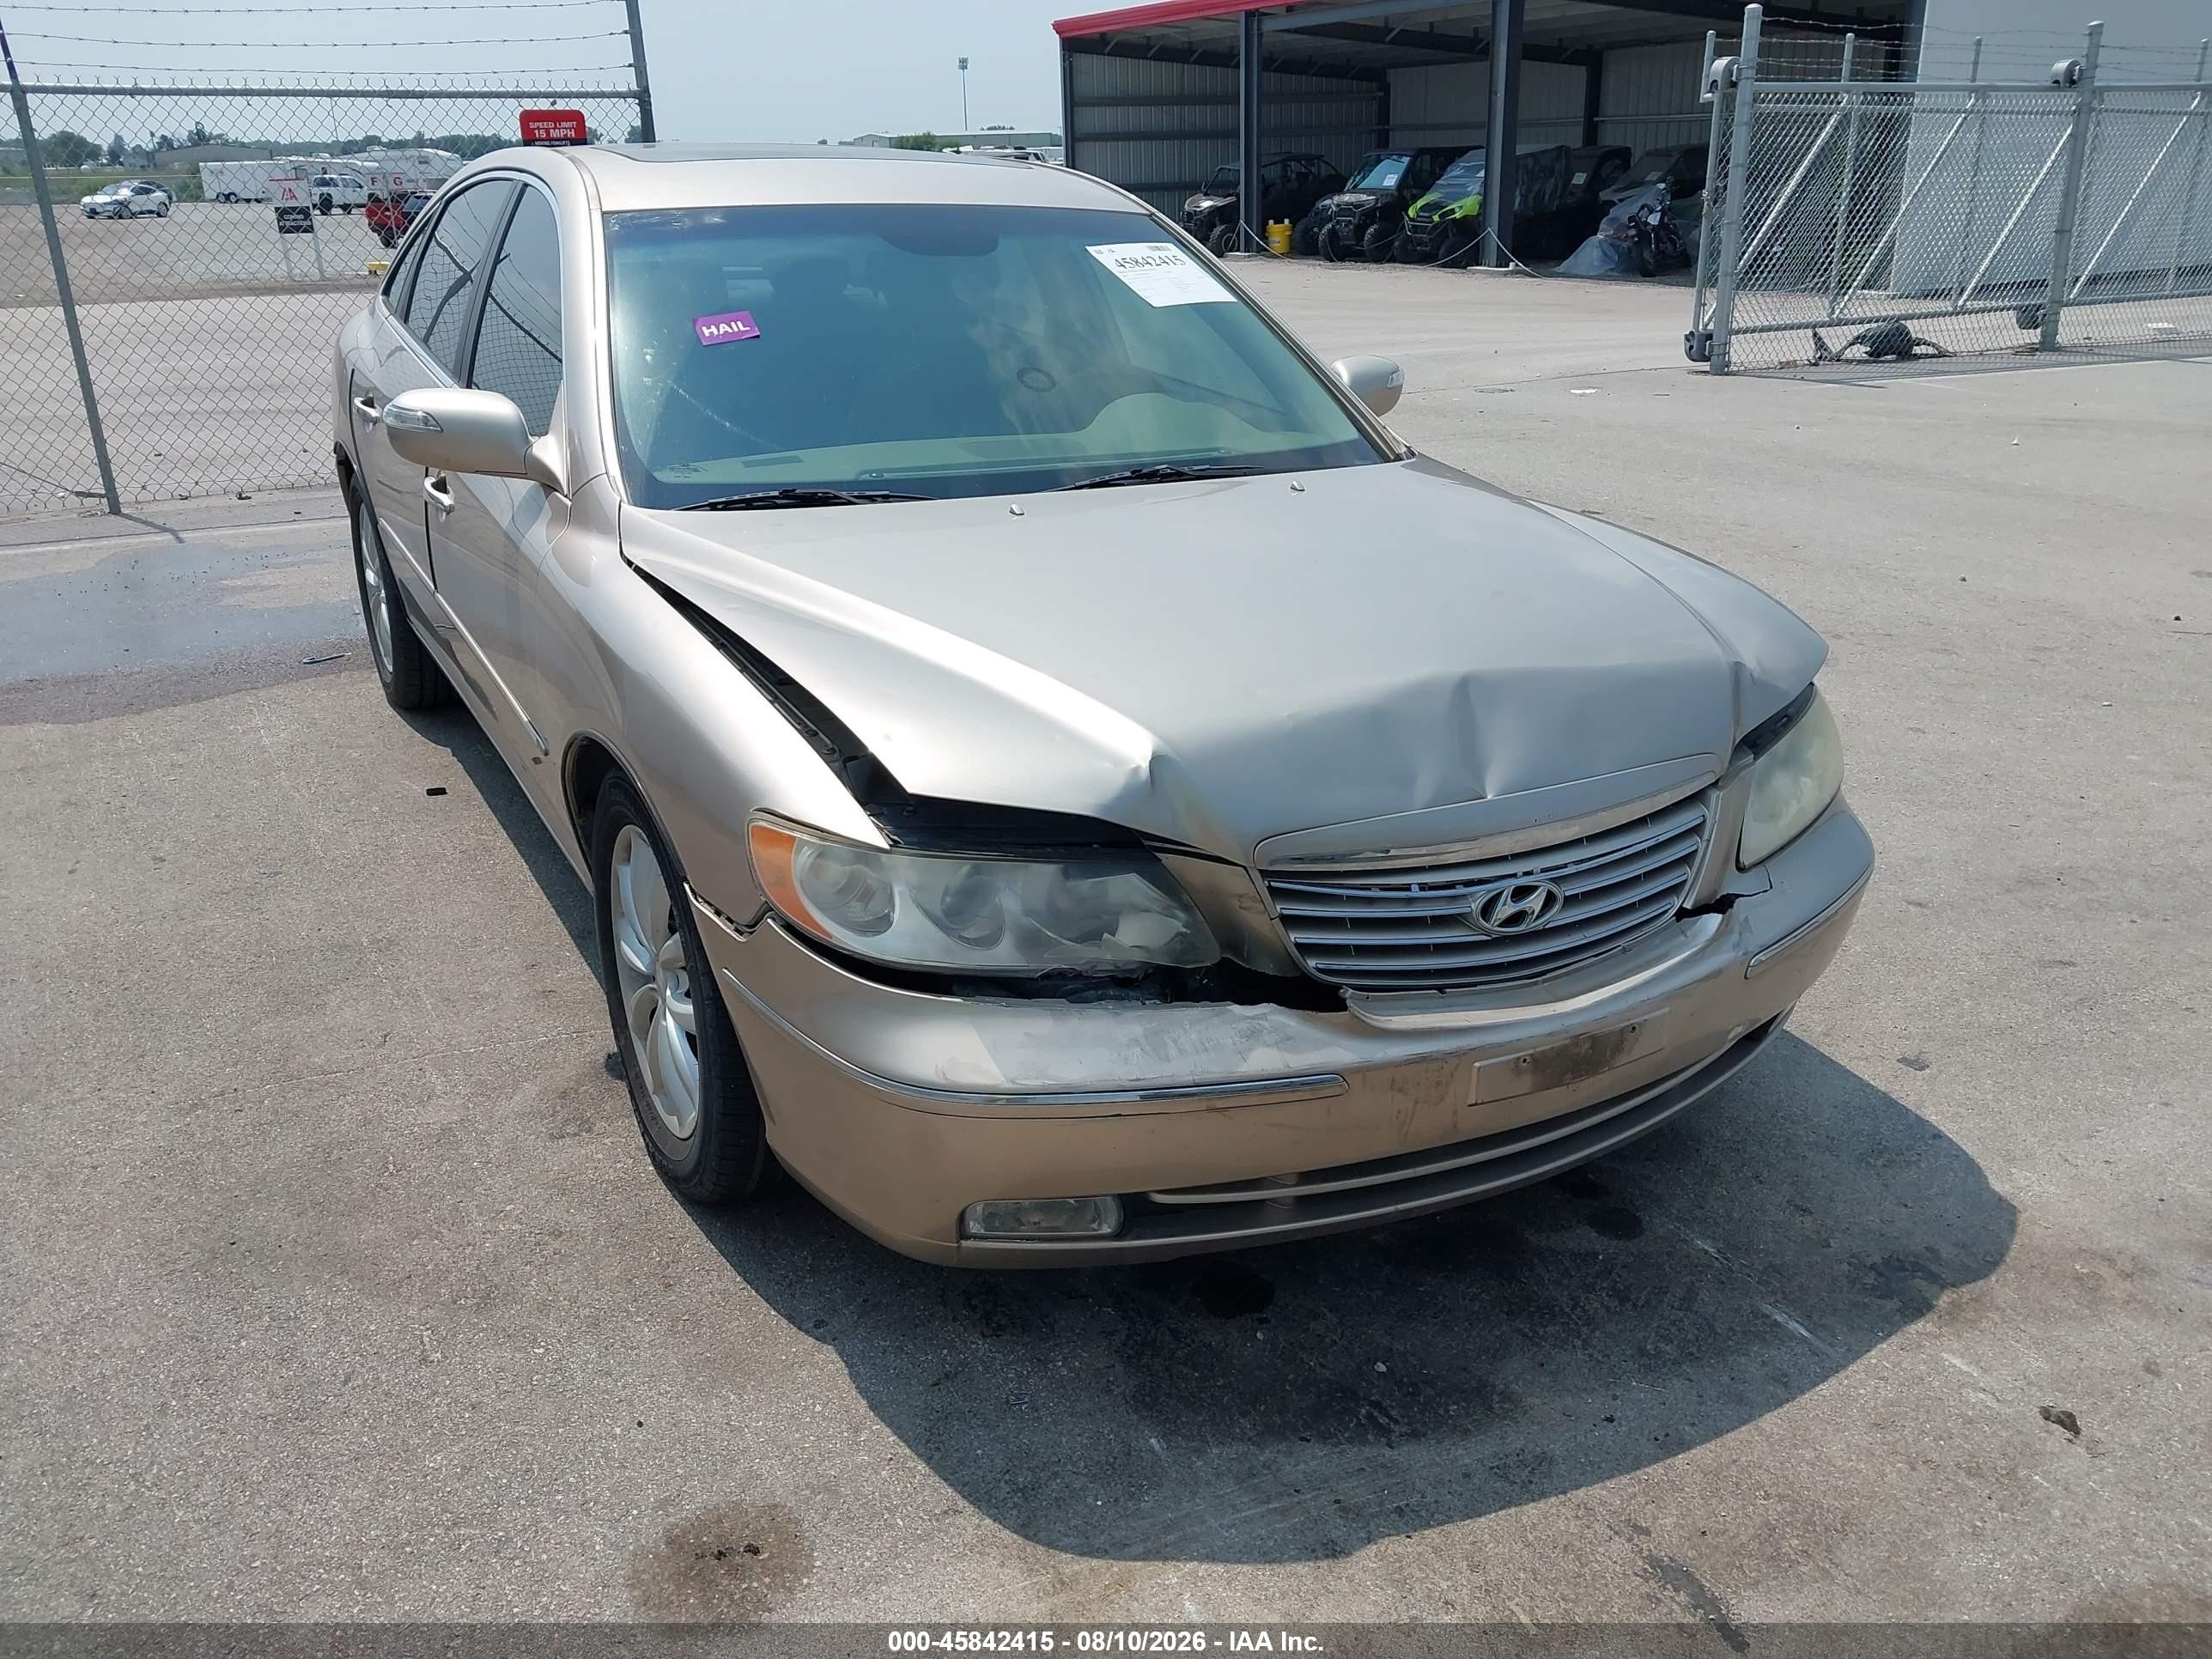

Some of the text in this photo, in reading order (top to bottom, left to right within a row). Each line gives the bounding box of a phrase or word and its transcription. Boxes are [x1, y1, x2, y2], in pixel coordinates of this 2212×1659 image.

[534, 129, 575, 137] 15 MPH
[370, 177, 378, 185] F
[393, 177, 403, 185] G
[1115, 255, 1186, 269] 45842415
[702, 320, 750, 337] HAIL
